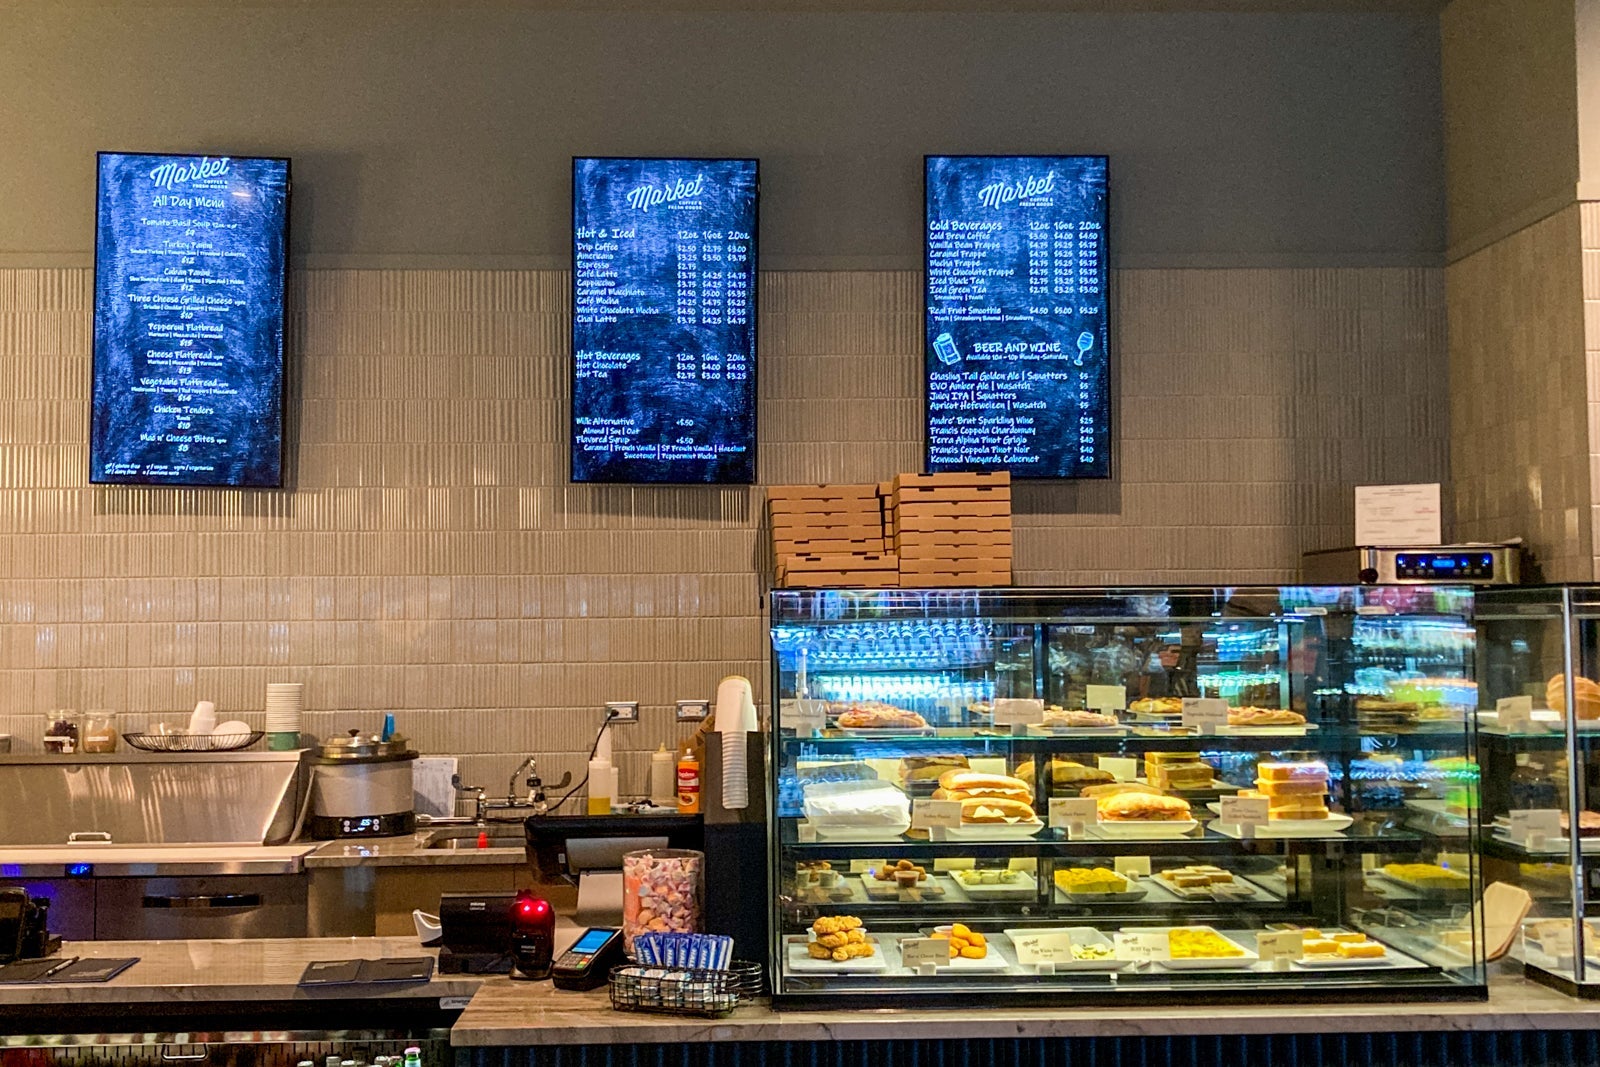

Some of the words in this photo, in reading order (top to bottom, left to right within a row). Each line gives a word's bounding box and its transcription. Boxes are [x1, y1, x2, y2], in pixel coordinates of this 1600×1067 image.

[150, 157, 230, 190] Market
[627, 173, 703, 212] Market
[978, 170, 1054, 210] Market
[153, 196, 167, 207] All
[170, 196, 192, 209] Day
[195, 197, 224, 208] Menu
[141, 218, 170, 226] Tomato
[192, 220, 210, 228] Soup
[930, 221, 948, 230] Cold
[951, 221, 1002, 234] Beverages
[1029, 222, 1050, 230] 12oz
[1054, 221, 1074, 230] 16oz
[1079, 222, 1101, 230] 20oz
[577, 227, 596, 239] Hot
[599, 229, 607, 238] &
[612, 228, 635, 238] Iced
[677, 231, 698, 239] 12oz
[703, 231, 723, 239] 16oz
[728, 231, 750, 239] 20oz
[163, 240, 189, 249] Turkey
[577, 243, 593, 251] Drip
[595, 243, 618, 251] Coffee
[577, 252, 613, 260] Americano
[577, 261, 609, 269] Espresso
[164, 268, 186, 276] Cuban
[577, 280, 615, 288] Cappuccino
[930, 277, 947, 285] Iced
[930, 286, 947, 294] Iced
[949, 286, 970, 294] Green
[127, 294, 150, 302] Three
[153, 294, 178, 303] Cheese
[181, 295, 204, 304] Grilled
[148, 323, 184, 331] Pepperoni
[973, 343, 1003, 353] BEER
[1005, 343, 1027, 353] AND
[1030, 343, 1061, 352] WINE
[147, 350, 173, 358] Cheese
[175, 351, 212, 359] Flatbread
[576, 350, 593, 361] Hot
[595, 352, 641, 364] Beverages
[677, 372, 695, 380] $2.75
[702, 372, 720, 380] $3.00
[930, 372, 960, 382] Chasing
[962, 372, 978, 380] Tail
[980, 372, 1005, 381] Golden
[1027, 372, 1067, 382] Squatters
[1079, 372, 1088, 380] $5
[140, 378, 178, 387] Vegetable
[930, 392, 949, 400] Juicy
[977, 392, 1016, 401] Squatters
[183, 406, 214, 414] Tenders
[930, 402, 958, 410] Apricot
[960, 401, 1005, 410] Hefeweizen
[957, 417, 977, 425] Brut
[978, 417, 1014, 426] Sparkling
[930, 427, 958, 435] Francis
[960, 427, 989, 435] Coppola
[991, 427, 1036, 435] Chardonnay
[166, 434, 192, 442] Cheese
[193, 435, 215, 443] Bites
[609, 437, 629, 445] Syrup
[955, 437, 979, 445] Alpina
[1003, 436, 1027, 446] Grigio
[930, 446, 958, 454] Francis
[960, 446, 989, 454] Coppola
[930, 455, 963, 463] Kenwood
[965, 455, 1001, 464] Vineyards
[1003, 455, 1039, 463] Cabernet
